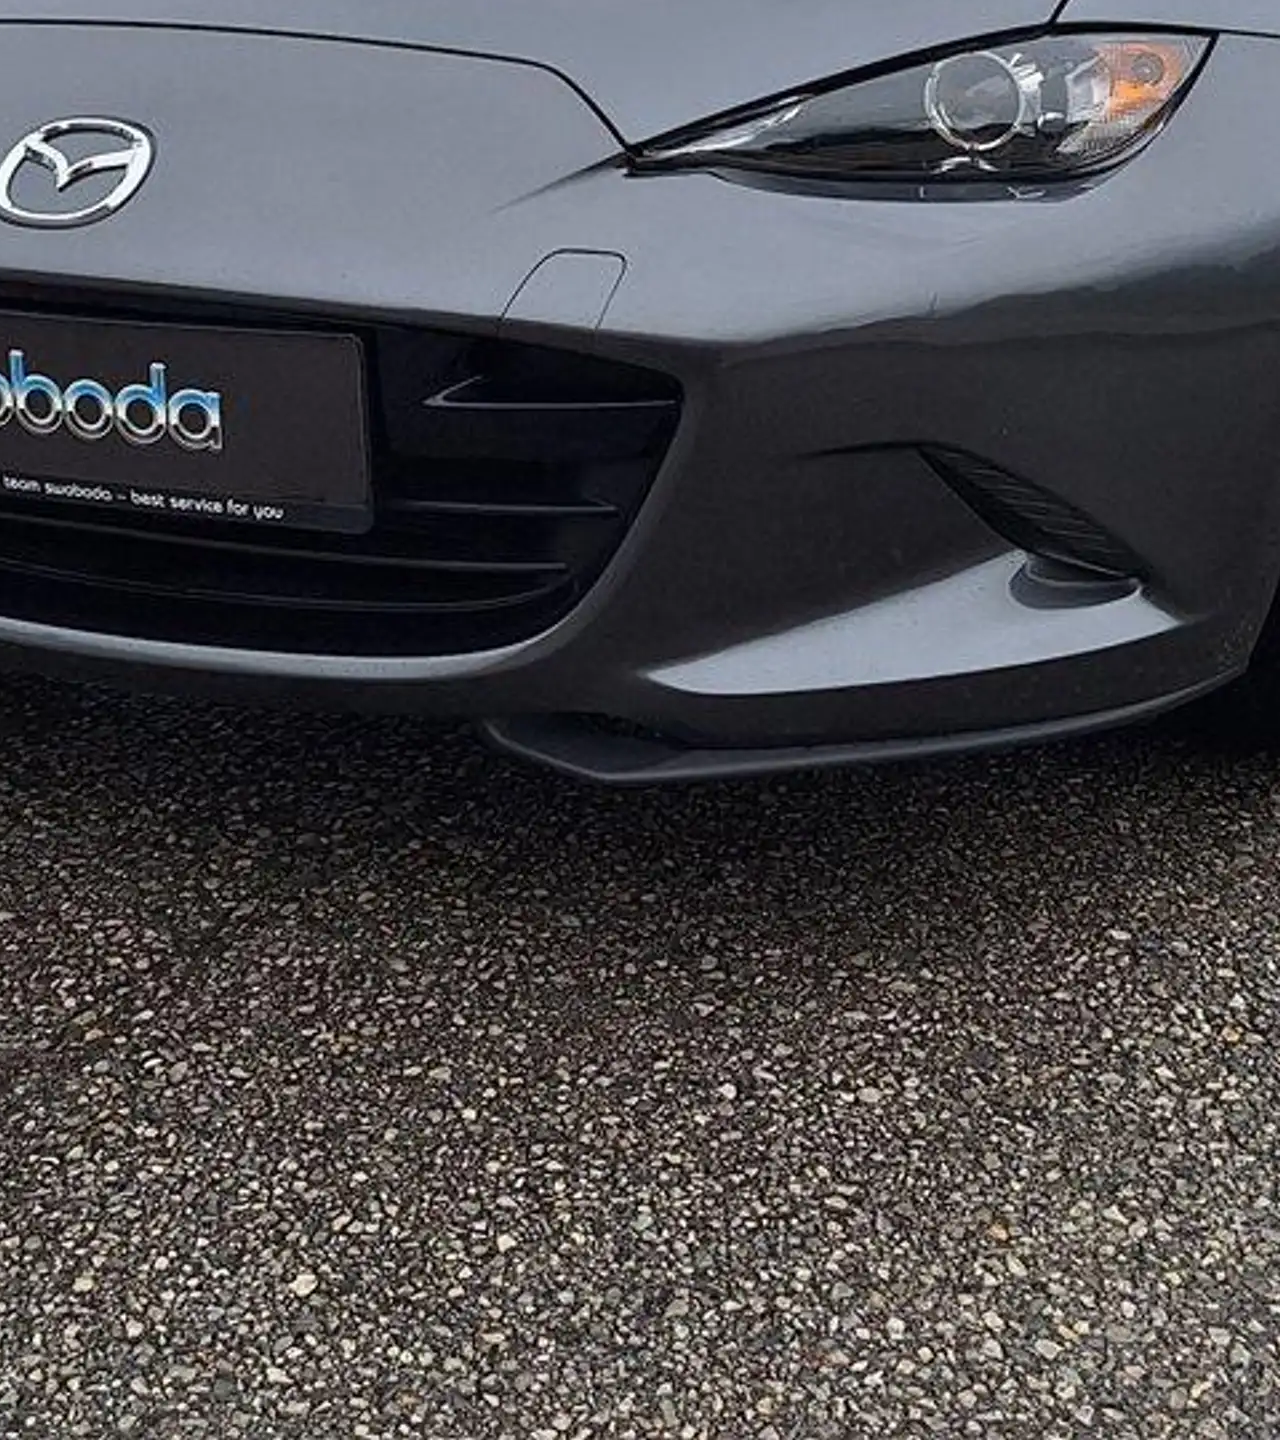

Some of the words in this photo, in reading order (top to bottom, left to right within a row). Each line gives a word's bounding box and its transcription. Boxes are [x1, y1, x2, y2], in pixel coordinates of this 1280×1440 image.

[2, 474, 41, 493] team
[44, 481, 113, 502] swoboda
[130, 488, 166, 508] best
[169, 496, 224, 513] service
[227, 499, 249, 516] for
[253, 504, 284, 521] you
